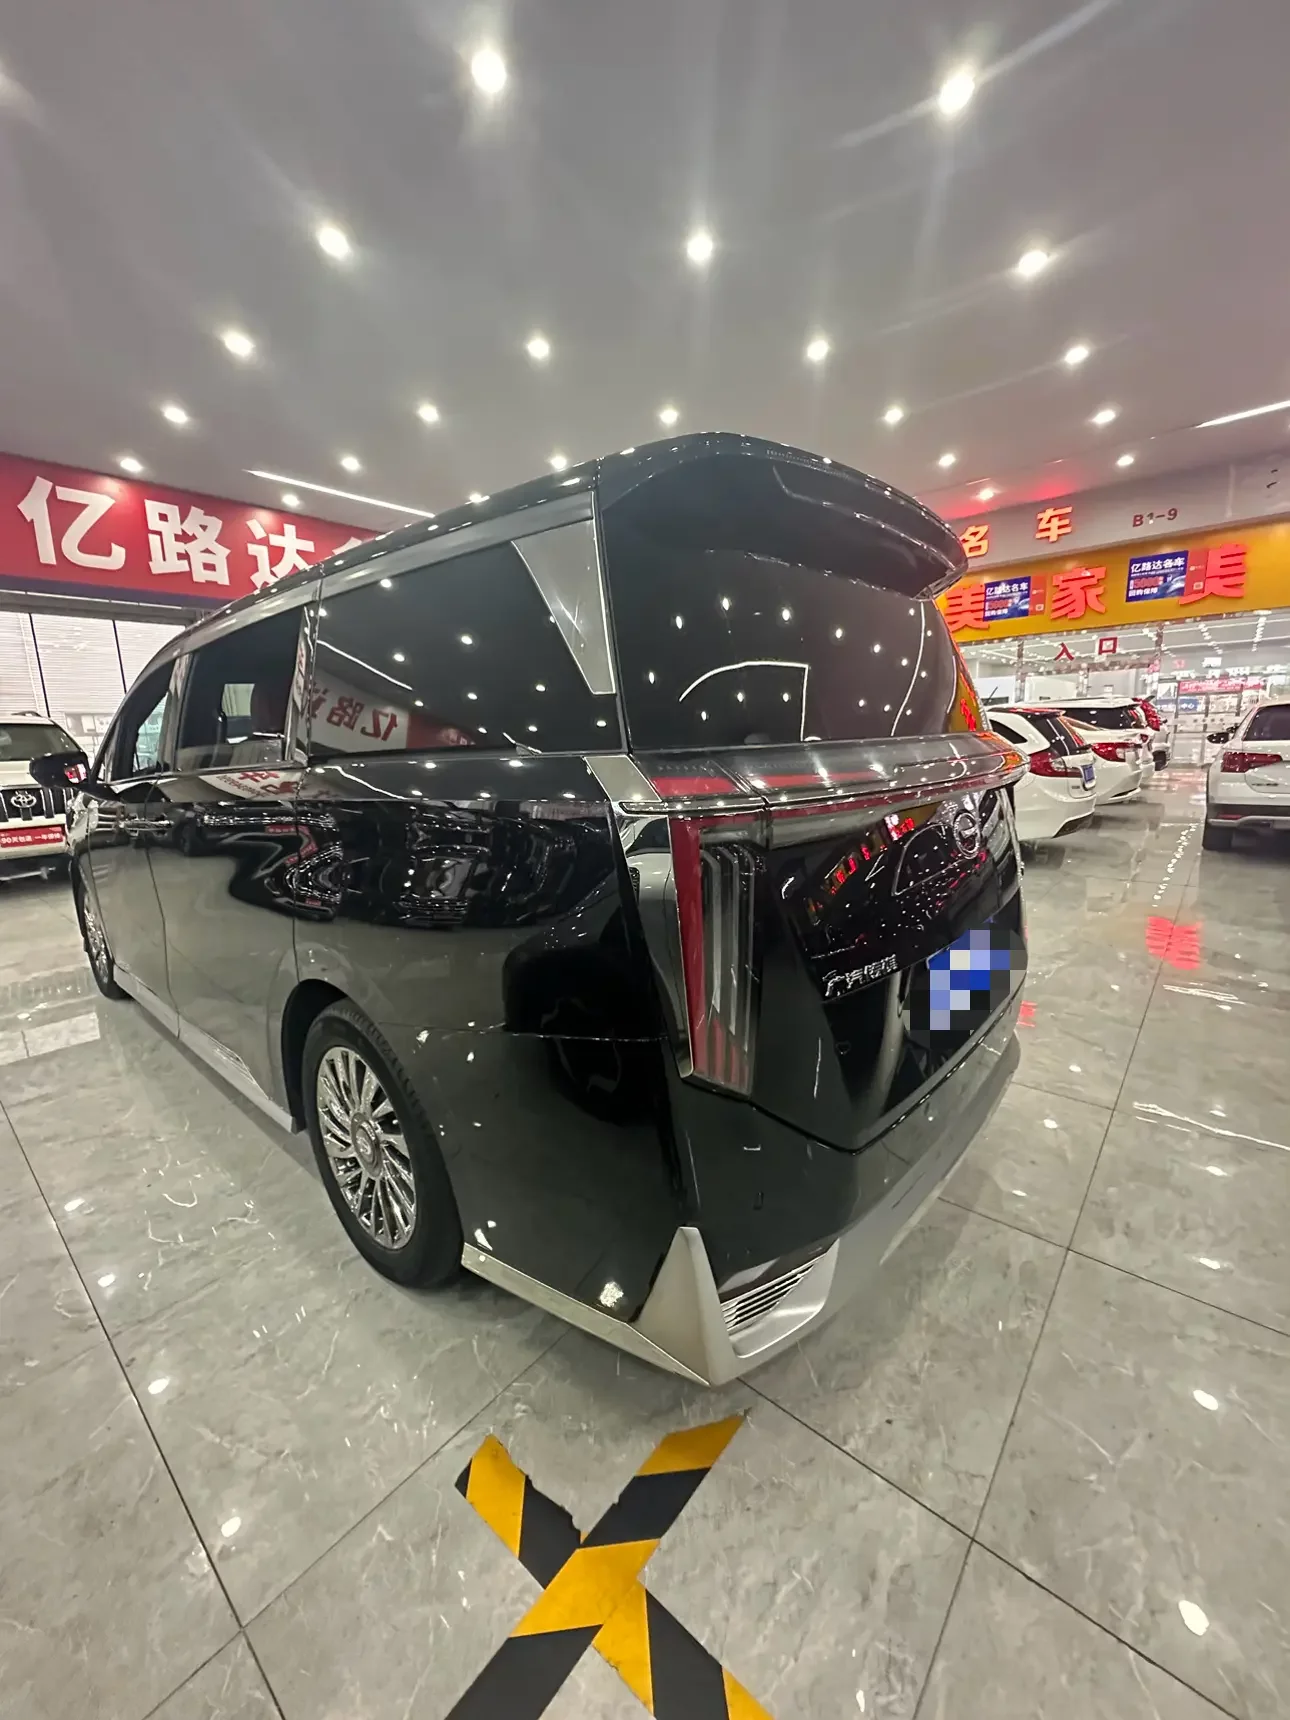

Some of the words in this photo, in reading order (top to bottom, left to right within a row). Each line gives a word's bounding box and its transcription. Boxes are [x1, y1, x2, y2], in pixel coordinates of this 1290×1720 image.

[18, 476, 370, 588] 亿路达
[959, 506, 1074, 558] 名车
[1132, 508, 1178, 528] B1-9
[1054, 637, 1118, 661] 入口
